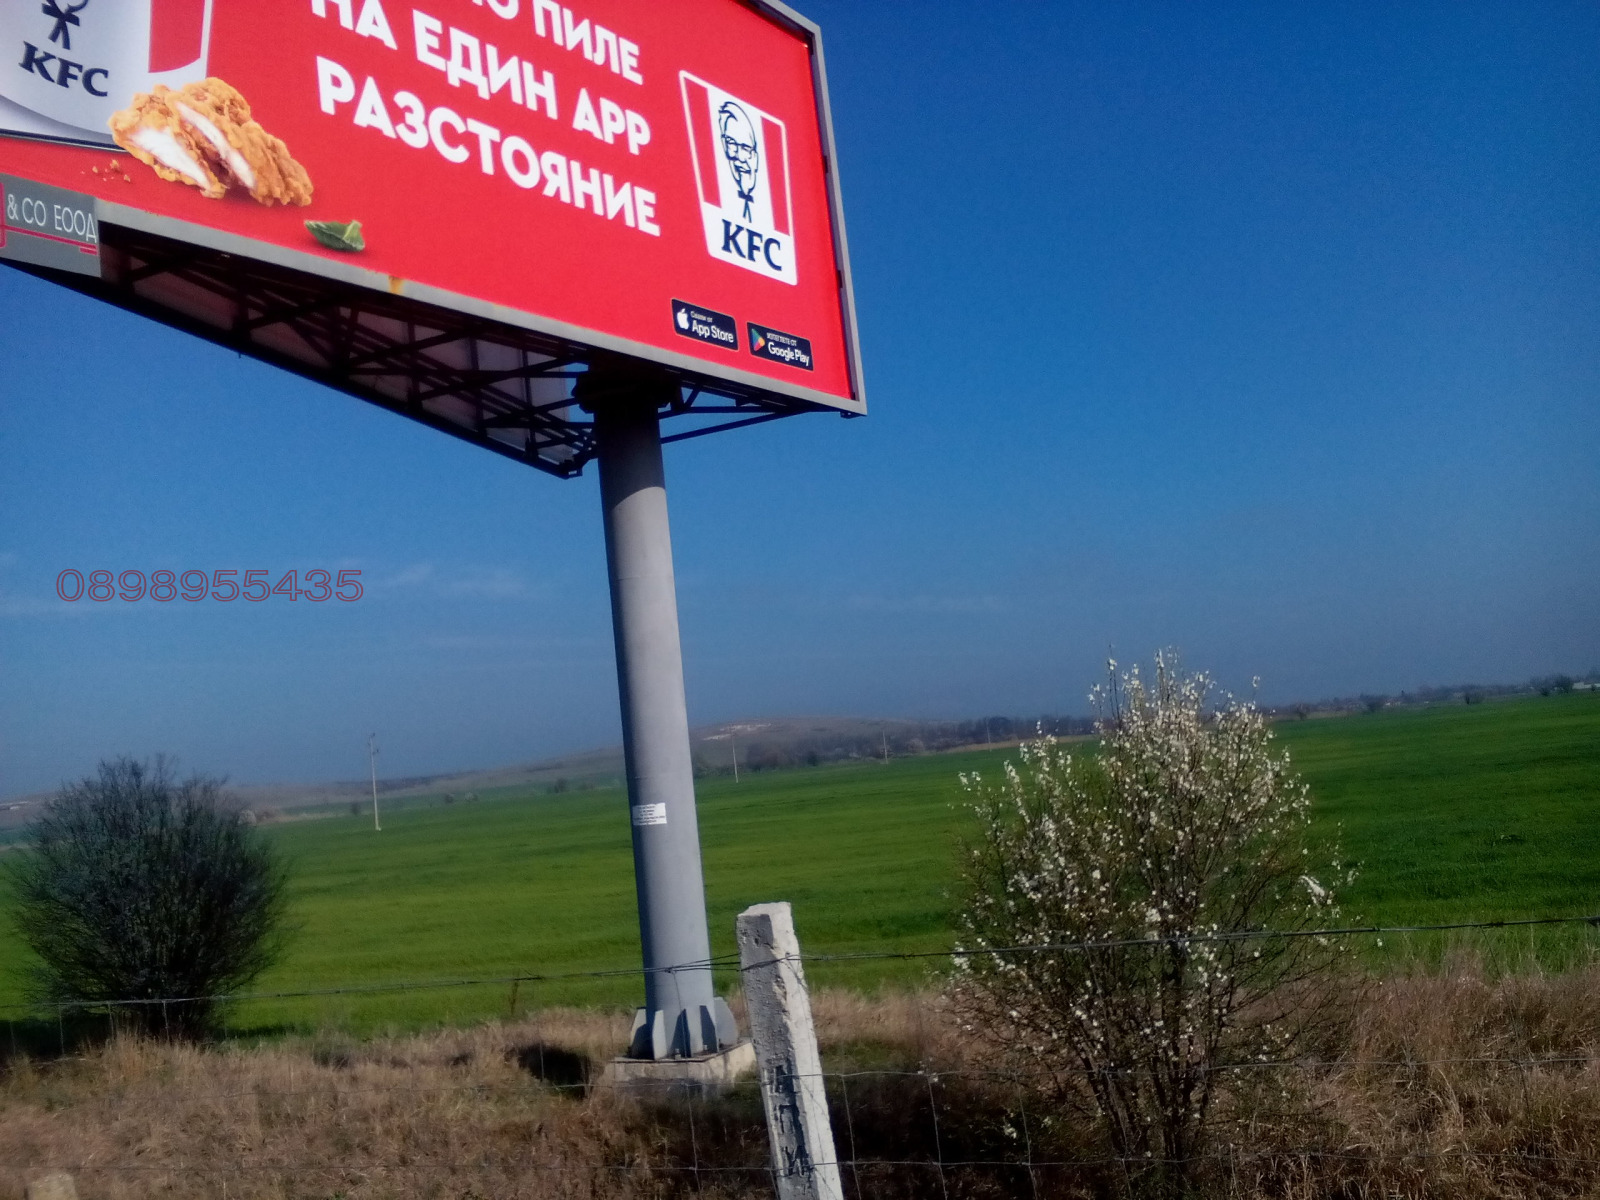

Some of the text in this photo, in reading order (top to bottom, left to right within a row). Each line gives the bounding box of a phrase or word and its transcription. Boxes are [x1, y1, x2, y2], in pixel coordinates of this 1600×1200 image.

[18, 40, 109, 98] KFC
[412, 9, 559, 121] ЕДИН
[533, 0, 644, 86] ПИЛЕ
[316, 55, 661, 237] РАЗСТОЯНИЕ
[721, 218, 782, 271] KFC
[691, 320, 734, 343] App Store
[768, 341, 810, 367] Google Play
